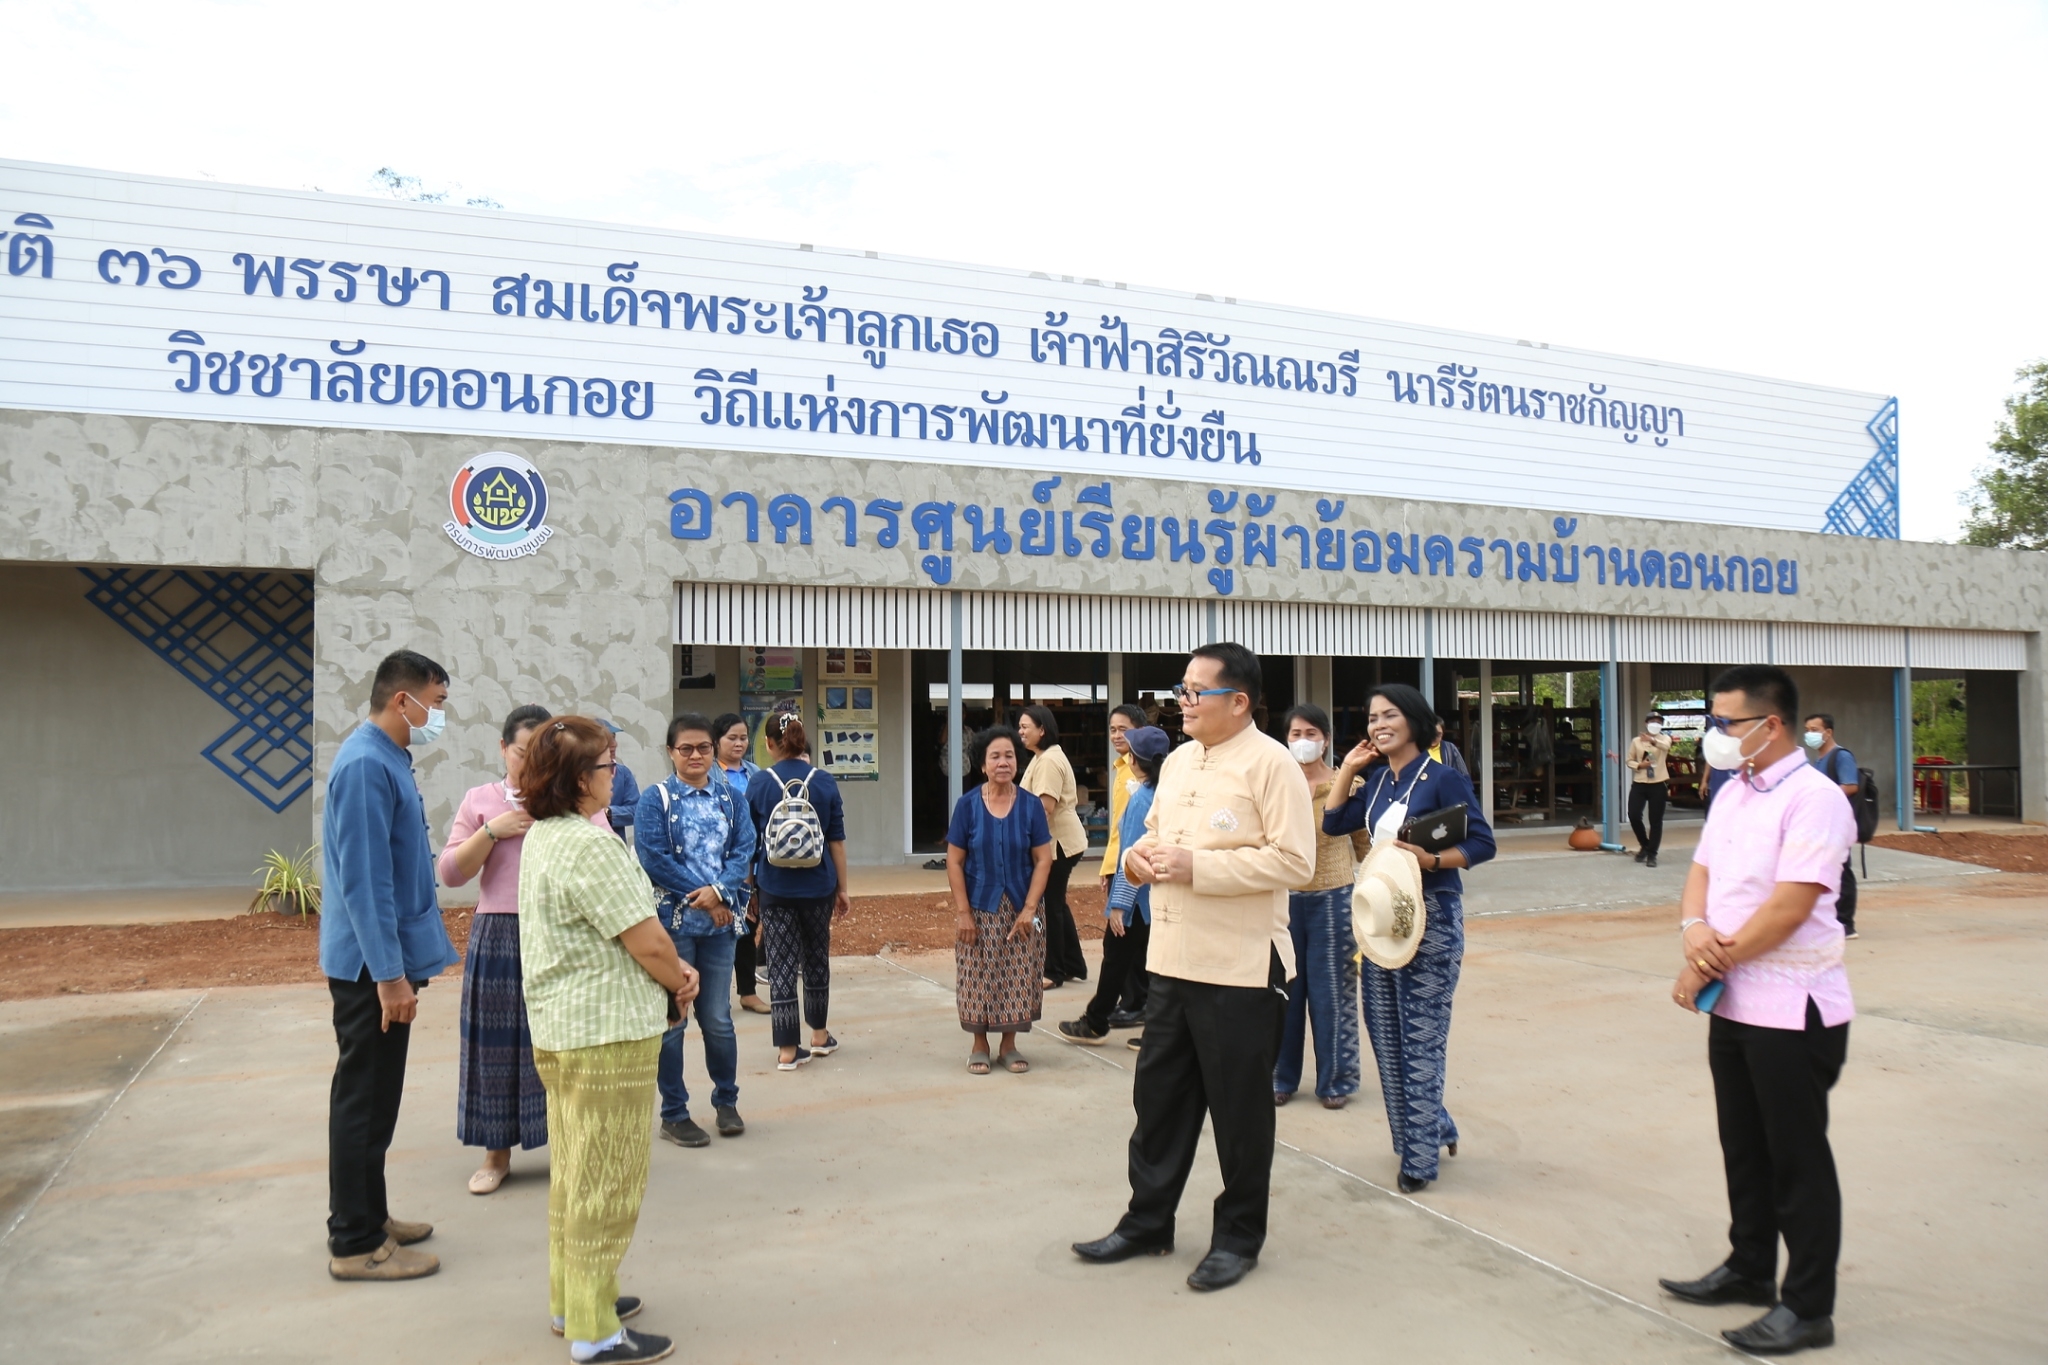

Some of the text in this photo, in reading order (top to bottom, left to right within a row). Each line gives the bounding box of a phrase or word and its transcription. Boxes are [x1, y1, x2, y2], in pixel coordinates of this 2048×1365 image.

[0, 212, 1685, 448] ติ ๓๖ พรรษา สมเด็จพระเจ้าลูกเธอ เจ้าฟ้าสิริวัณณวรี นารีรัตนราชกัญญา
[168, 330, 1262, 466] วิชชาลัยดอนกอย วิถีแห่งการพัฒนาที่ยั่งยืน
[445, 523, 552, 558] กรมการพัฒนาชุมชน
[669, 475, 1798, 596] อาคารศูนย์เรียนรู้ผ้าย้อมครามบ้านดอนกอย
